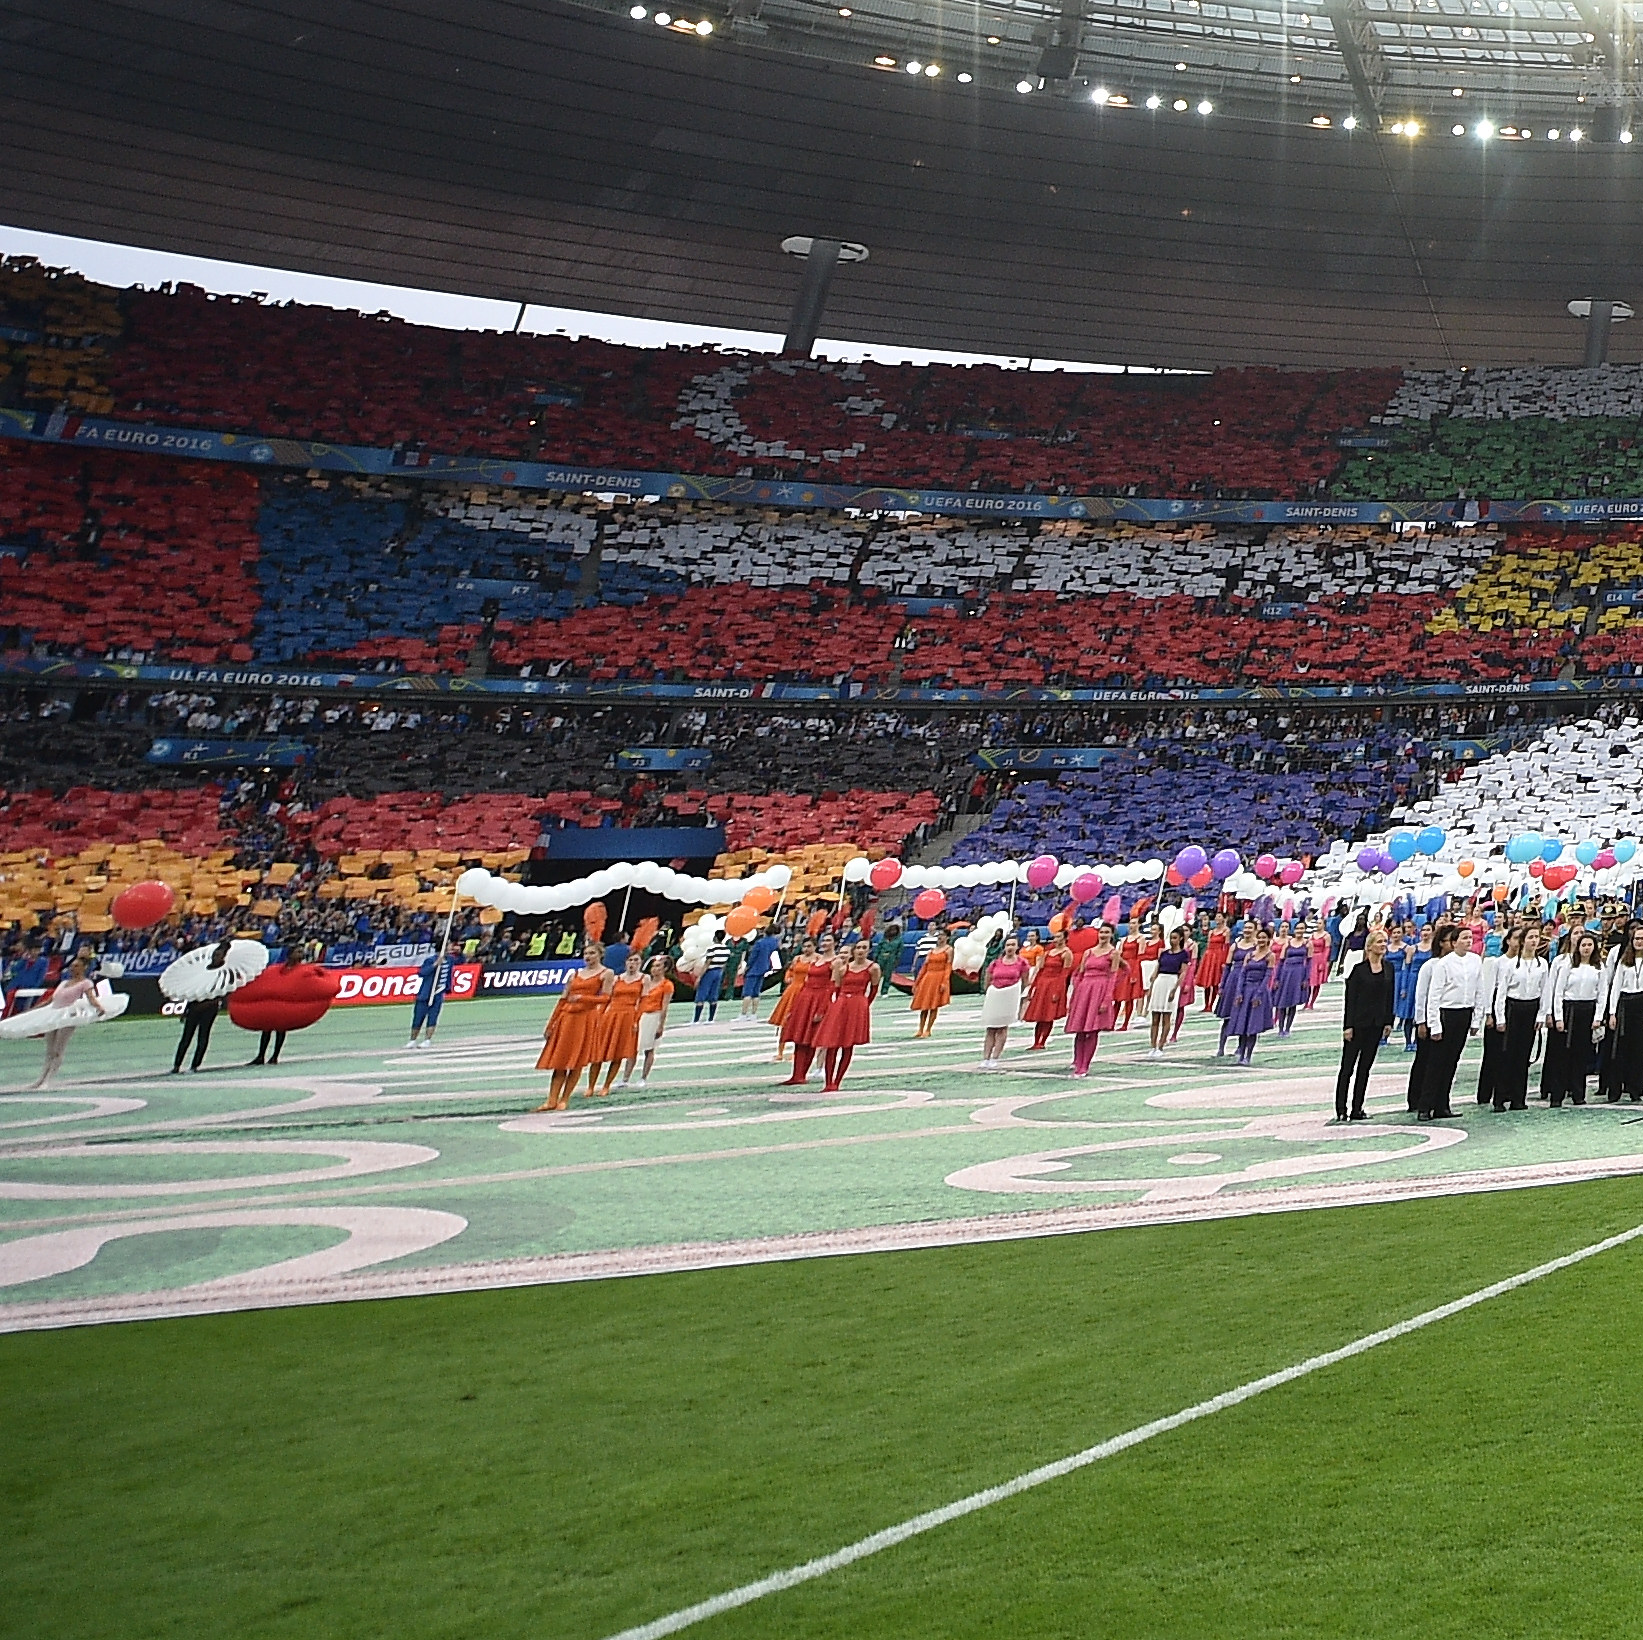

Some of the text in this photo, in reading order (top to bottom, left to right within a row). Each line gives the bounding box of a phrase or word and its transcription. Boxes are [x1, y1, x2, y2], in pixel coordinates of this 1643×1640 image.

[103, 428, 159, 445] EURO
[166, 434, 213, 451] 2016
[546, 471, 642, 489] SAINT-DENIS
[924, 495, 1042, 512] UEFA EURO 2016
[1575, 504, 1605, 515] UEFA
[1606, 503, 1639, 514] EURO
[1285, 507, 1358, 518] SAINT-DENIS
[1606, 593, 1623, 602] E14
[1263, 606, 1282, 616] H12
[222, 672, 273, 685] EURO
[276, 674, 322, 687] 2016
[694, 687, 753, 698] SAINT-D
[1465, 683, 1530, 695] SAINT-DENIS
[1093, 691, 1127, 701] UEFA
[1129, 691, 1158, 701] EUR
[332, 943, 436, 965] SARREGUE
[335, 971, 474, 999] Dona's
[483, 969, 560, 988] TURKISH
